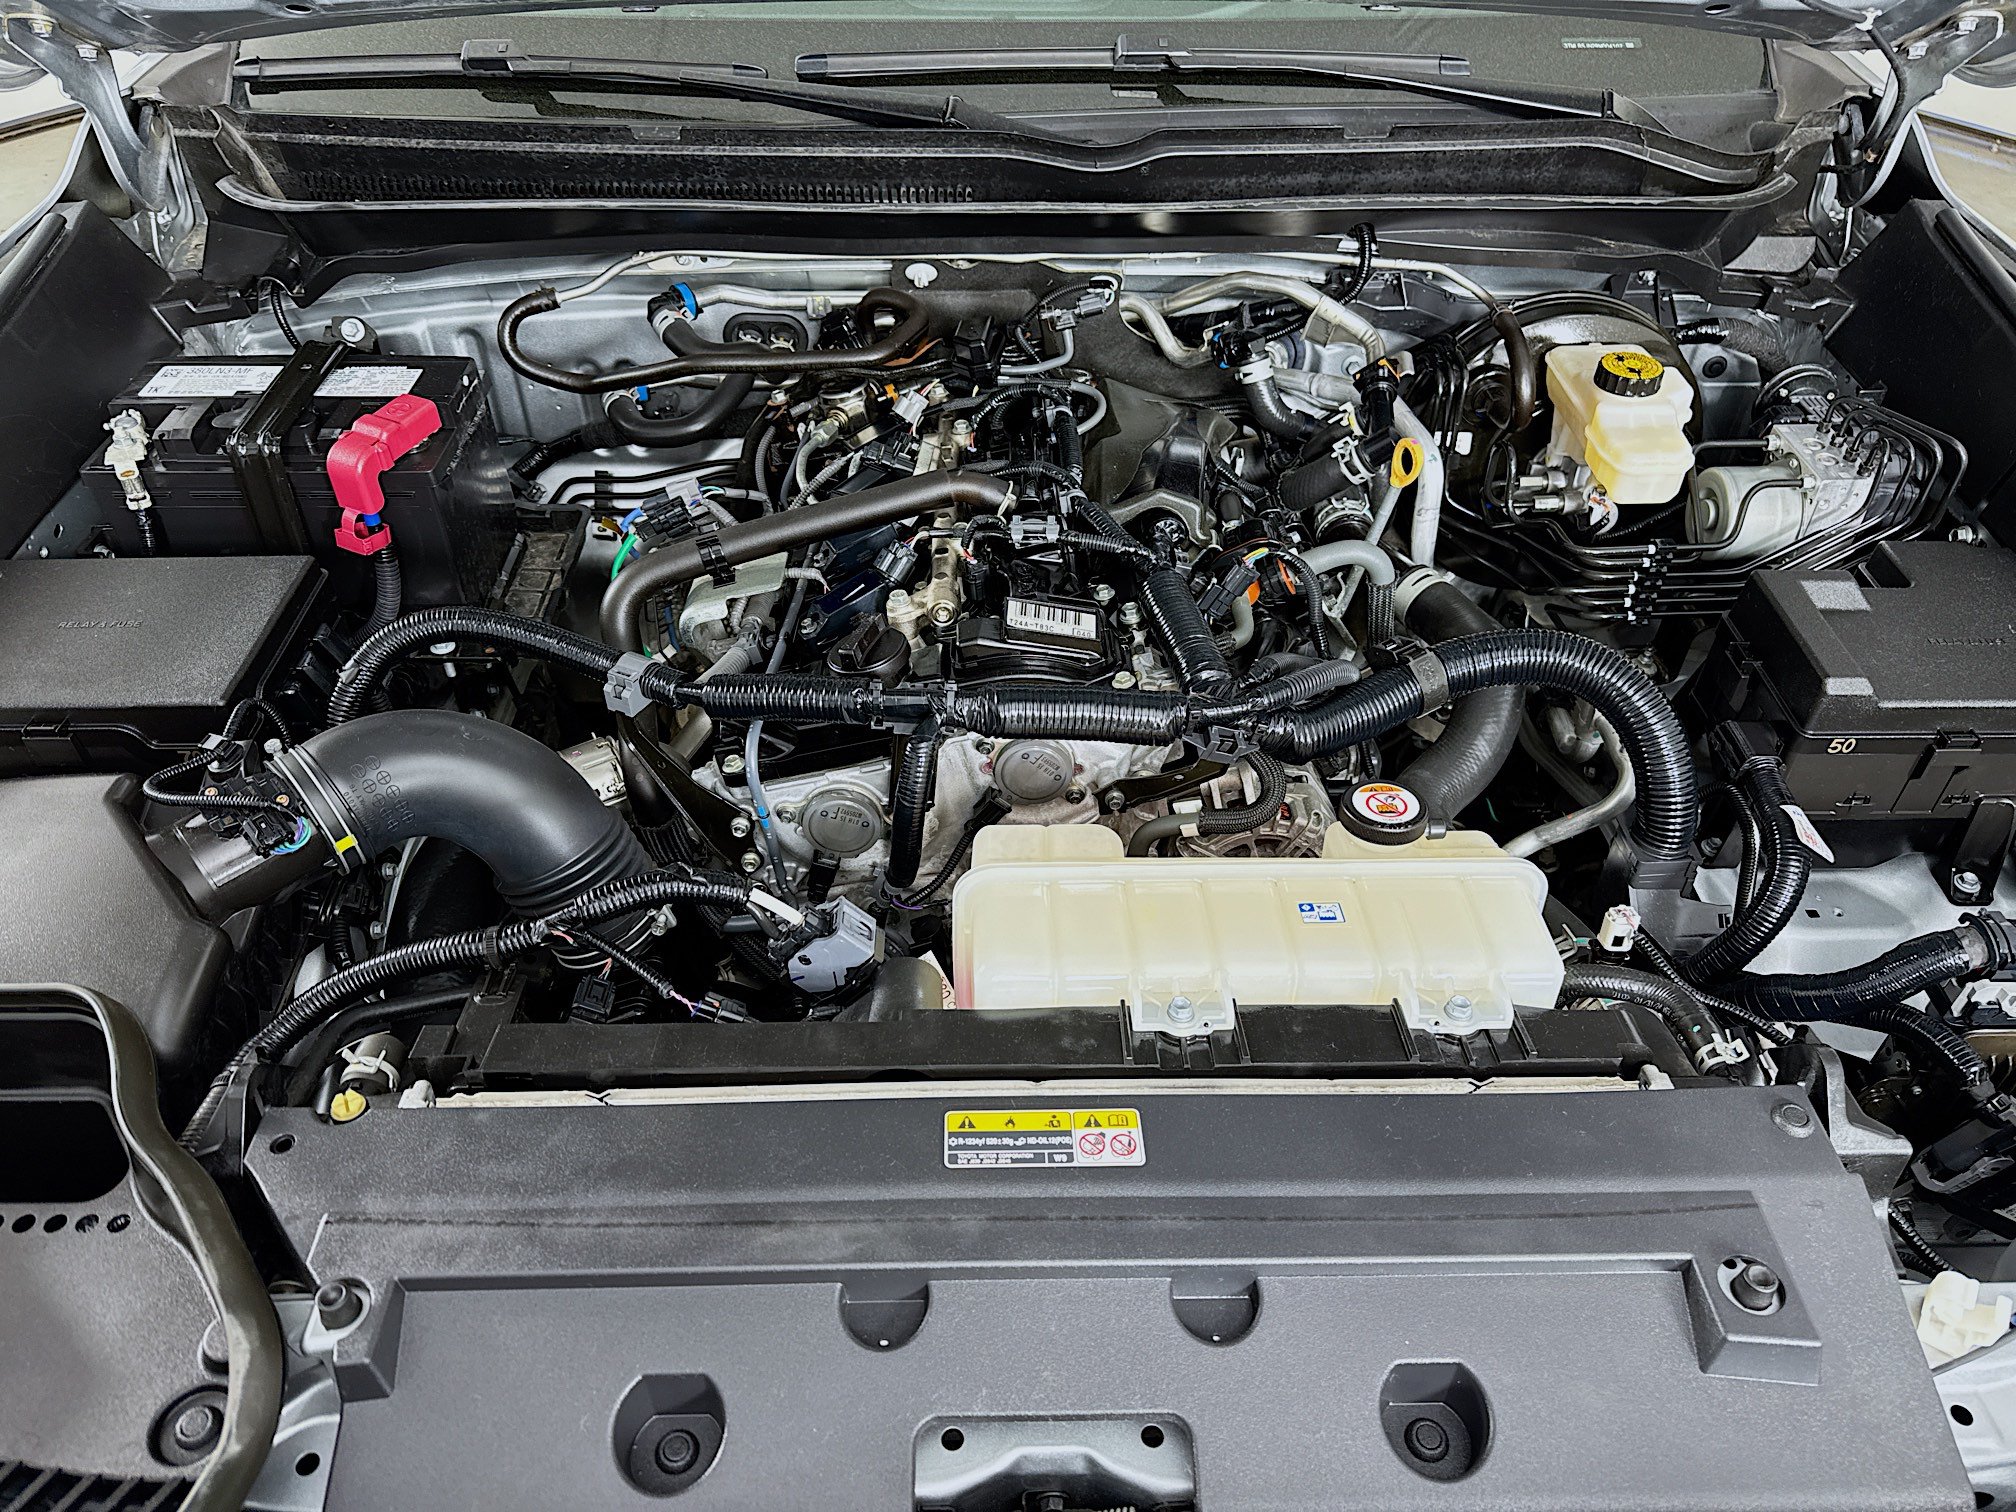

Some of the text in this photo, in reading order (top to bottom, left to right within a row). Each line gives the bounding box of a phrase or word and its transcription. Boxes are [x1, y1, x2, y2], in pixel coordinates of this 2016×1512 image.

[58, 620, 100, 629] RELAY
[109, 620, 143, 629] FUSE
[1827, 738, 1857, 754] 50
